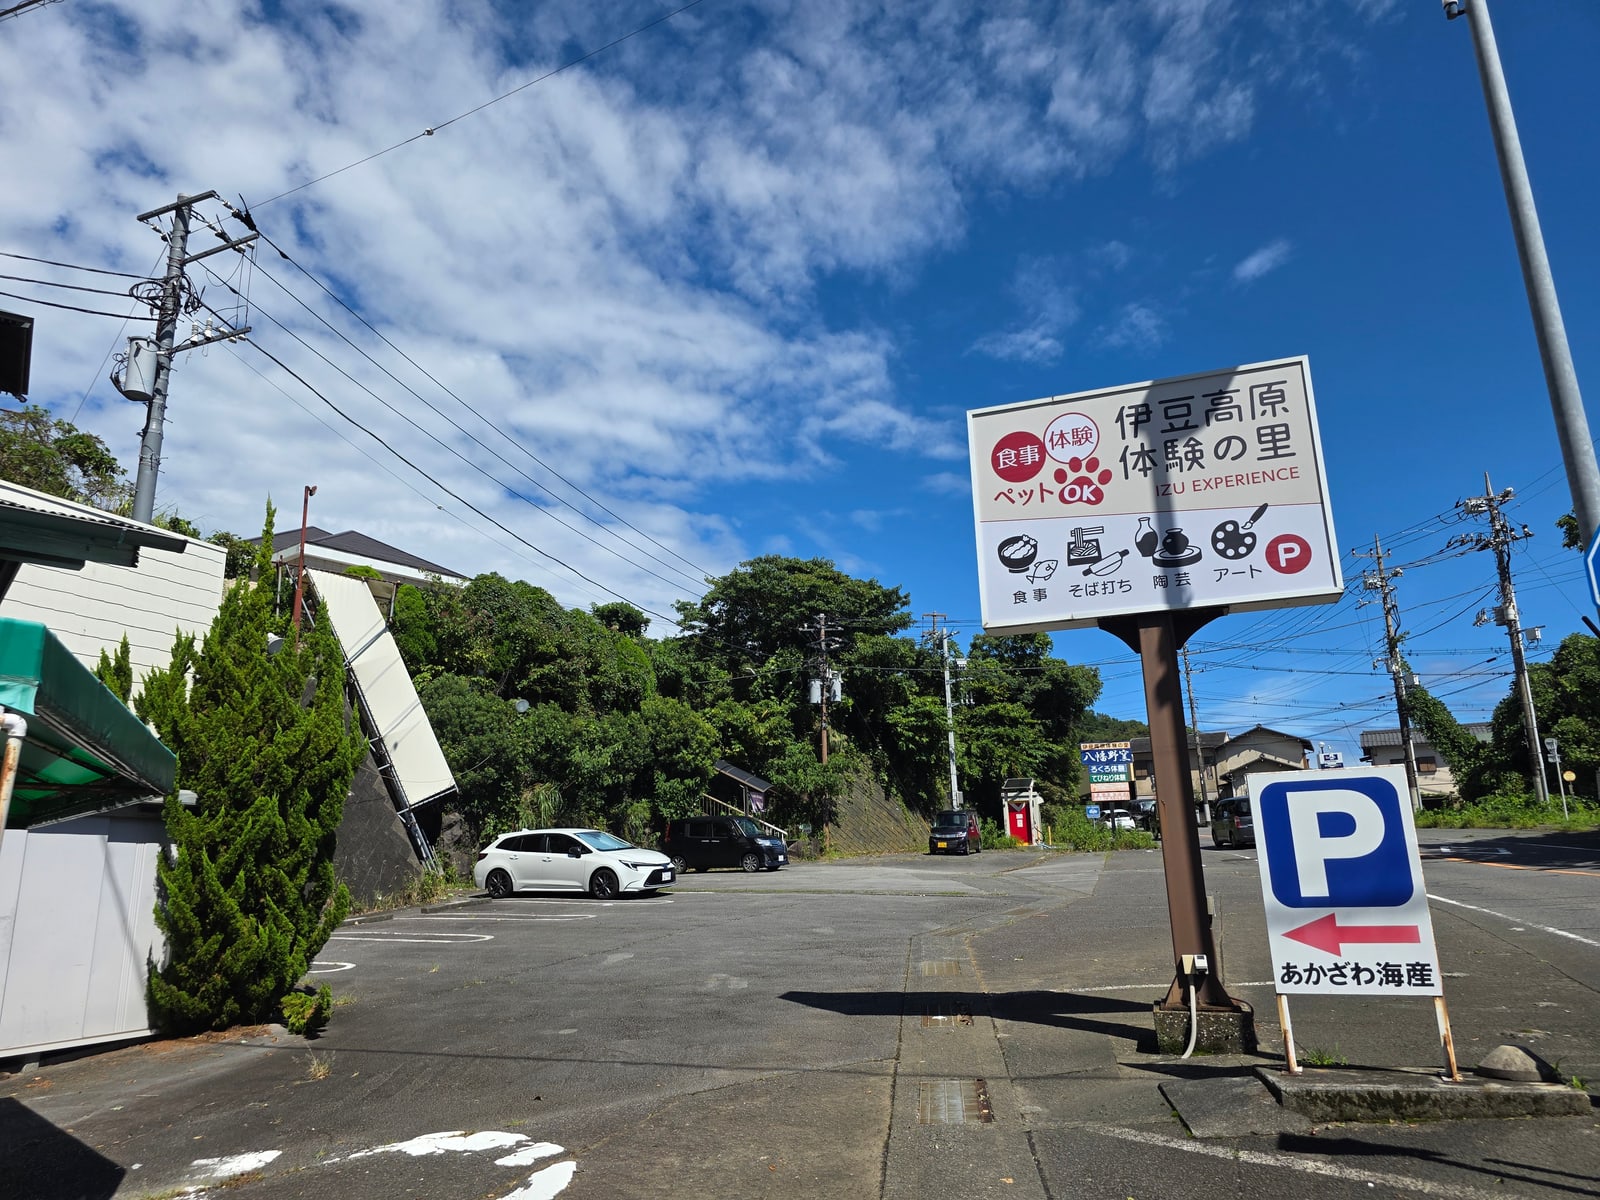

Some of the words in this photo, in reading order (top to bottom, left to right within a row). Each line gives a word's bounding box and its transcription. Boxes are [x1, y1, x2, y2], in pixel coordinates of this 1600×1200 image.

[1115, 380, 1289, 441] 伊豆高原
[1049, 426, 1094, 449] 体験
[996, 445, 1041, 469] 食事
[1119, 423, 1297, 480] 体験の里
[1063, 483, 1097, 502] OK
[1155, 484, 1186, 497] IZU
[1192, 466, 1300, 492] EXPERIENCE
[994, 482, 1055, 506] ペット
[1278, 542, 1300, 567] P
[1153, 572, 1192, 589] 陶芸
[1213, 564, 1263, 582] アート
[1012, 588, 1048, 604] 食事
[1068, 579, 1133, 598] そば打ち
[1286, 789, 1386, 897] P
[1280, 961, 1435, 988] あかざわ海産
